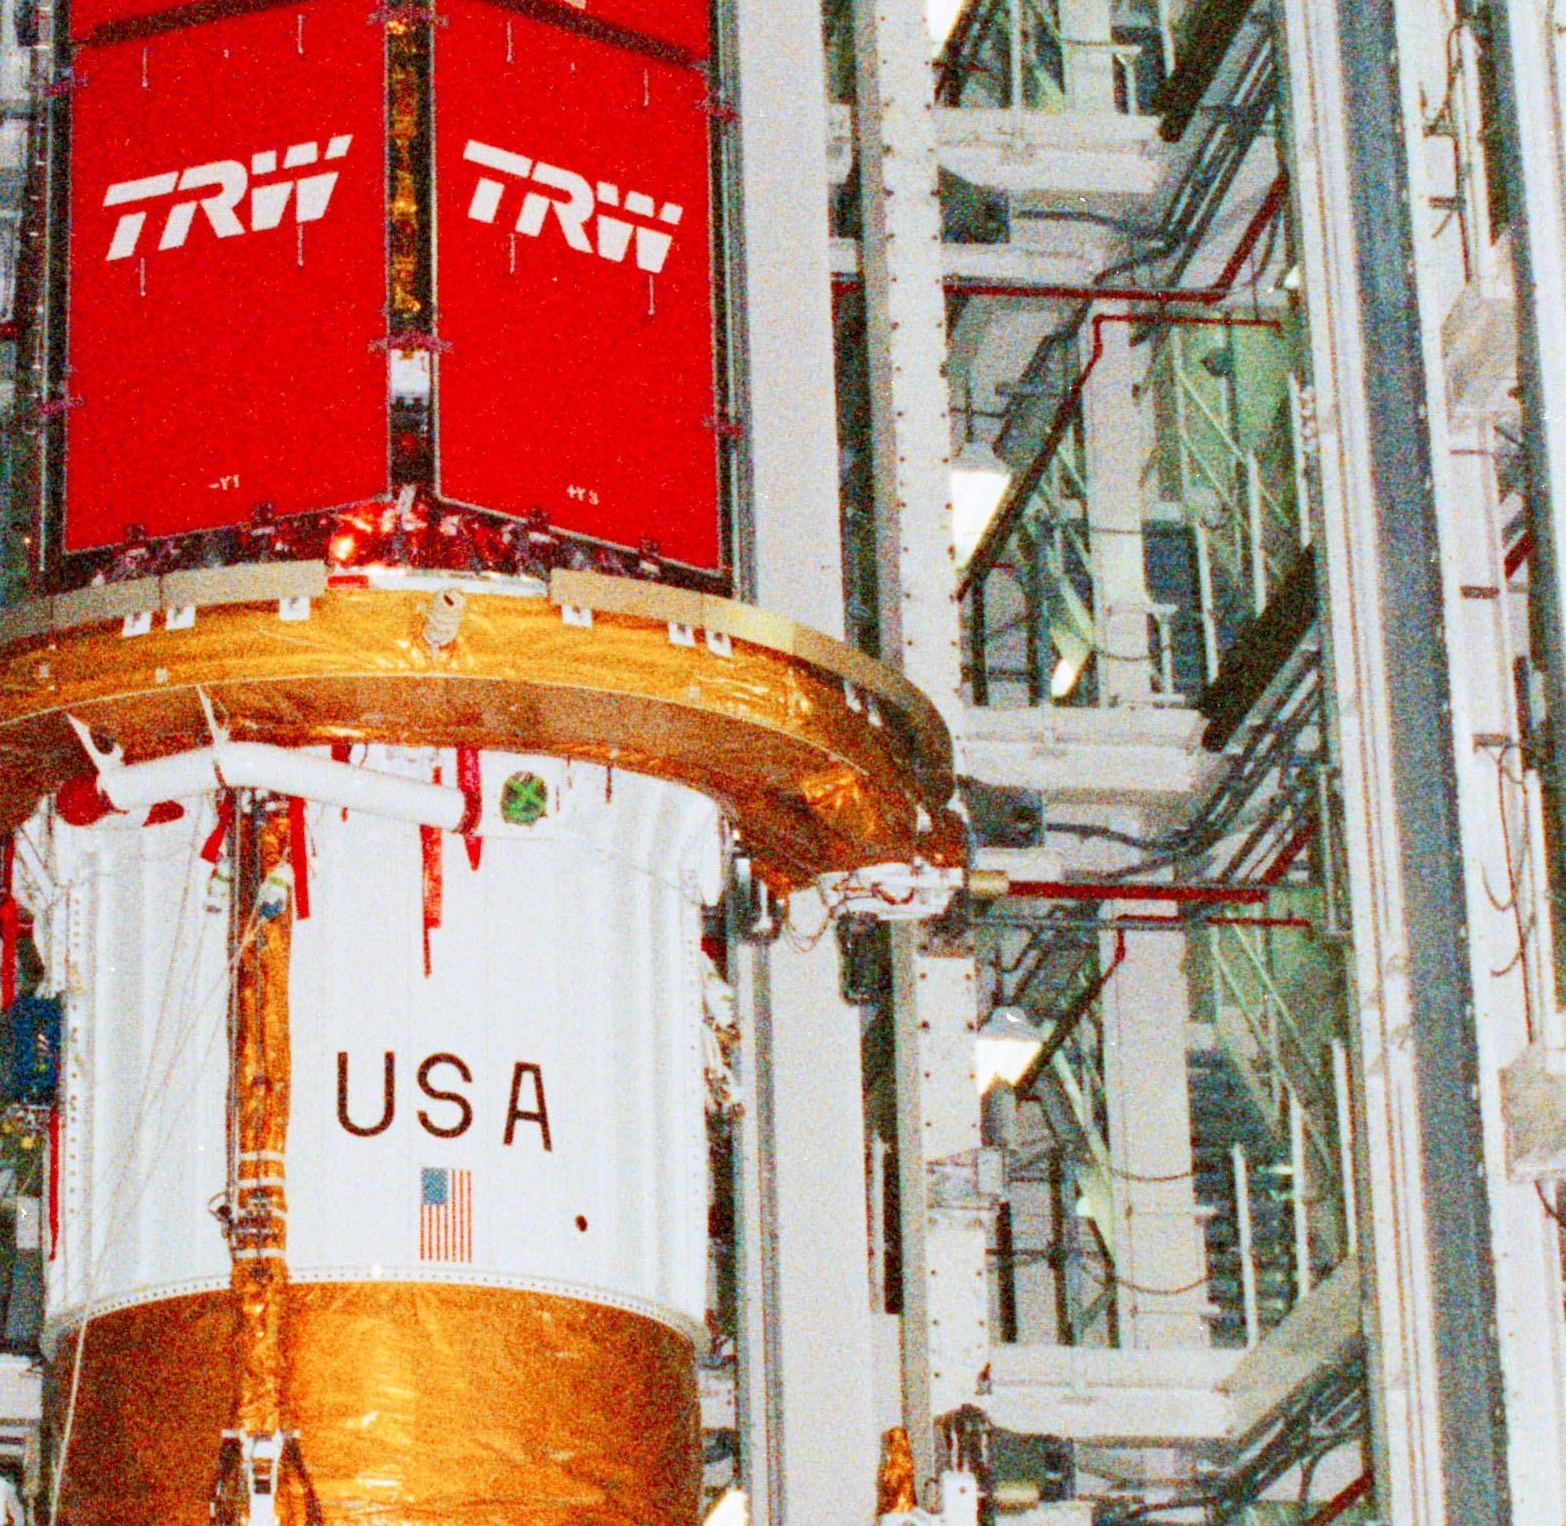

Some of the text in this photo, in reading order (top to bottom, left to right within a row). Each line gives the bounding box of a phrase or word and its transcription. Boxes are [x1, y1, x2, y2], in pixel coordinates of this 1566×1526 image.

[102, 133, 353, 262] TRW
[462, 139, 683, 274] TRW
[336, 1051, 552, 1153] USA
